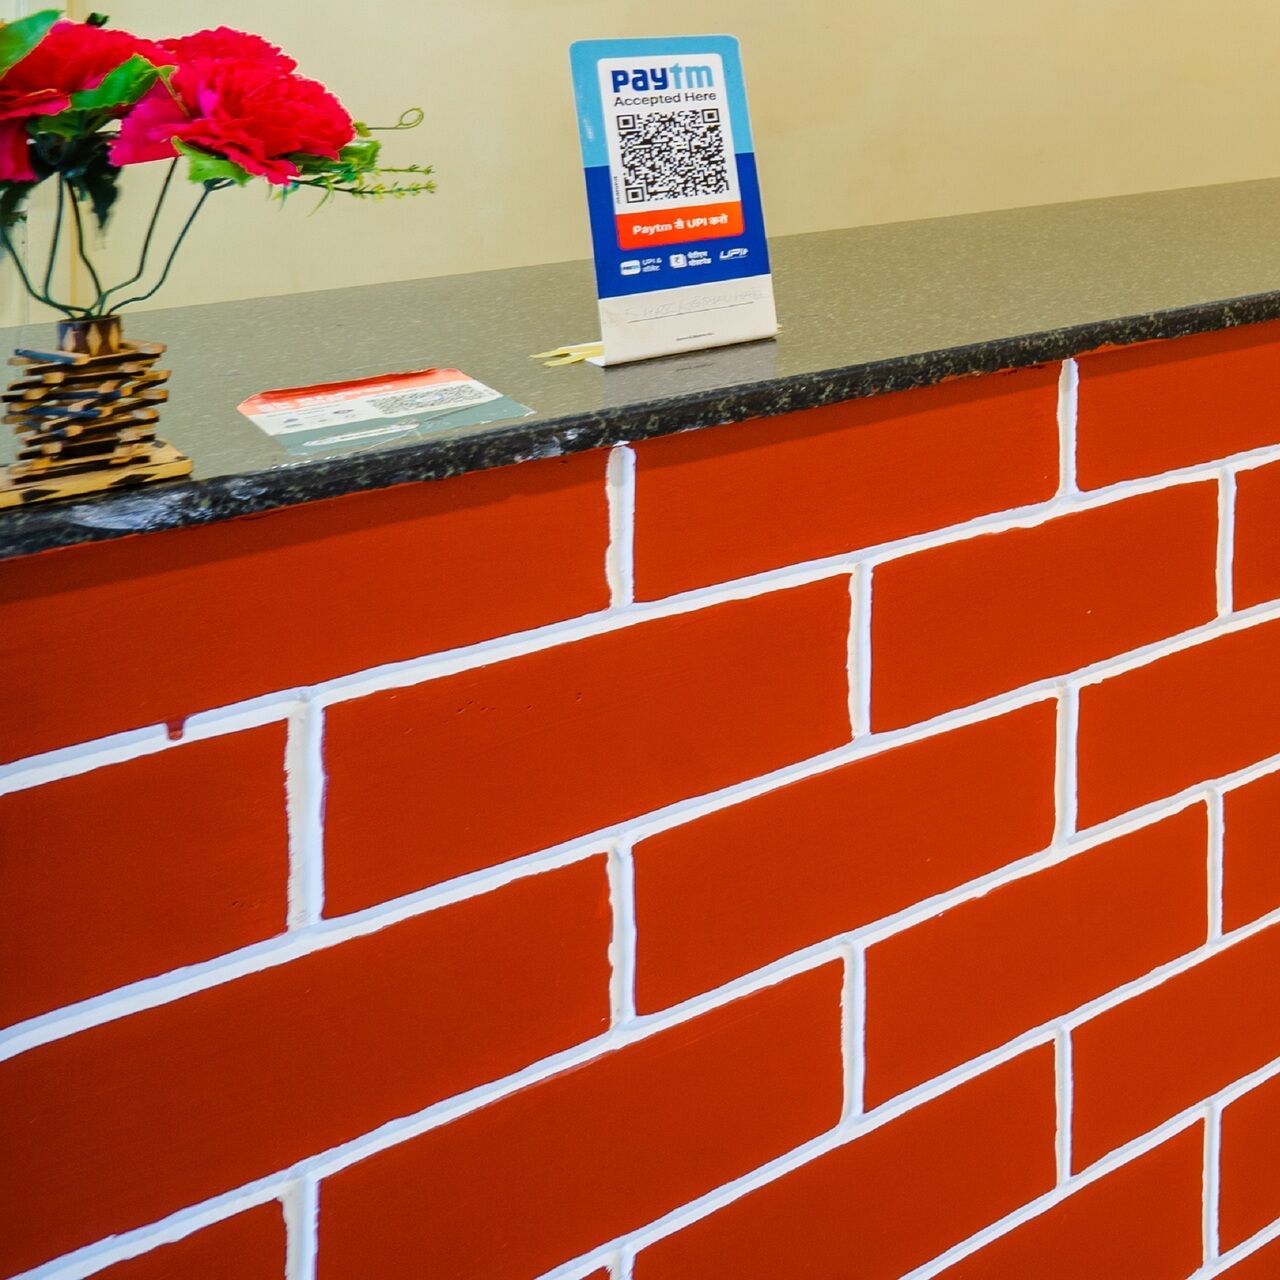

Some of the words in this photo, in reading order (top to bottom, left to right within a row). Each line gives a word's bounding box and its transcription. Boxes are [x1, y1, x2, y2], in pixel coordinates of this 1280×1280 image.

[614, 93, 681, 107] Accepted
[684, 92, 717, 101] Here
[632, 223, 672, 235] Paytm
[687, 217, 707, 229] UPI
